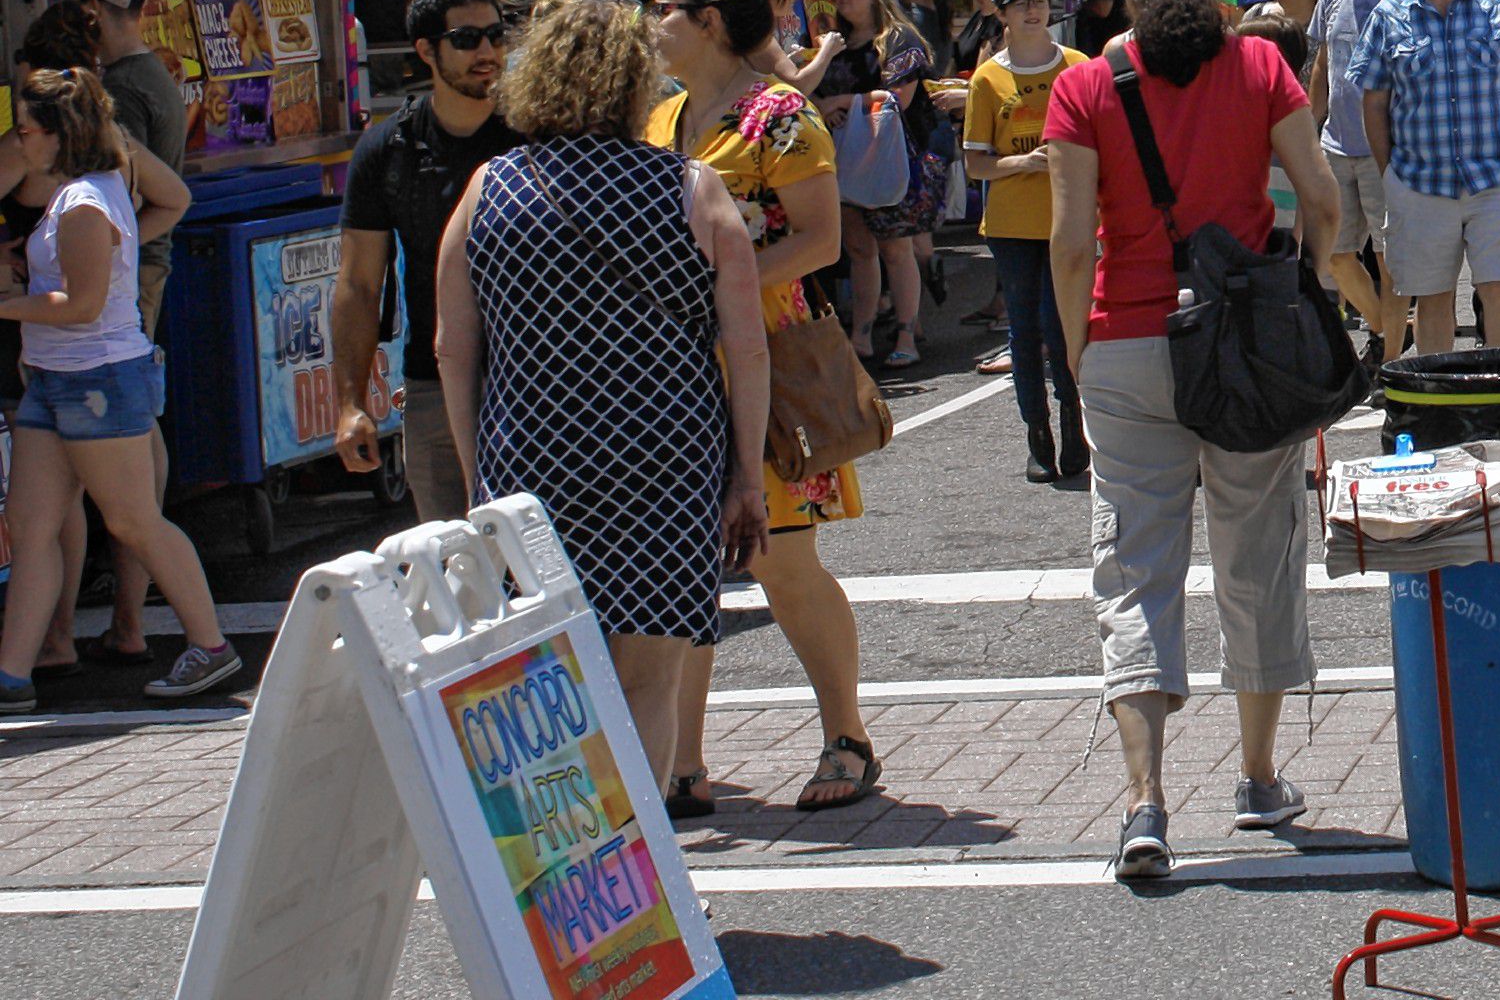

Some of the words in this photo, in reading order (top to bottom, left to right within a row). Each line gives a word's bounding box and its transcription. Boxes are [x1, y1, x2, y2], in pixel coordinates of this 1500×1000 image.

[203, 36, 244, 70] CHEESE
[271, 284, 325, 367] ICE
[1386, 480, 1450, 493] free
[1410, 579, 1497, 630] COCORD
[462, 663, 589, 785] CONCORD
[519, 764, 601, 858] ARTS
[532, 833, 643, 964] MARKET
